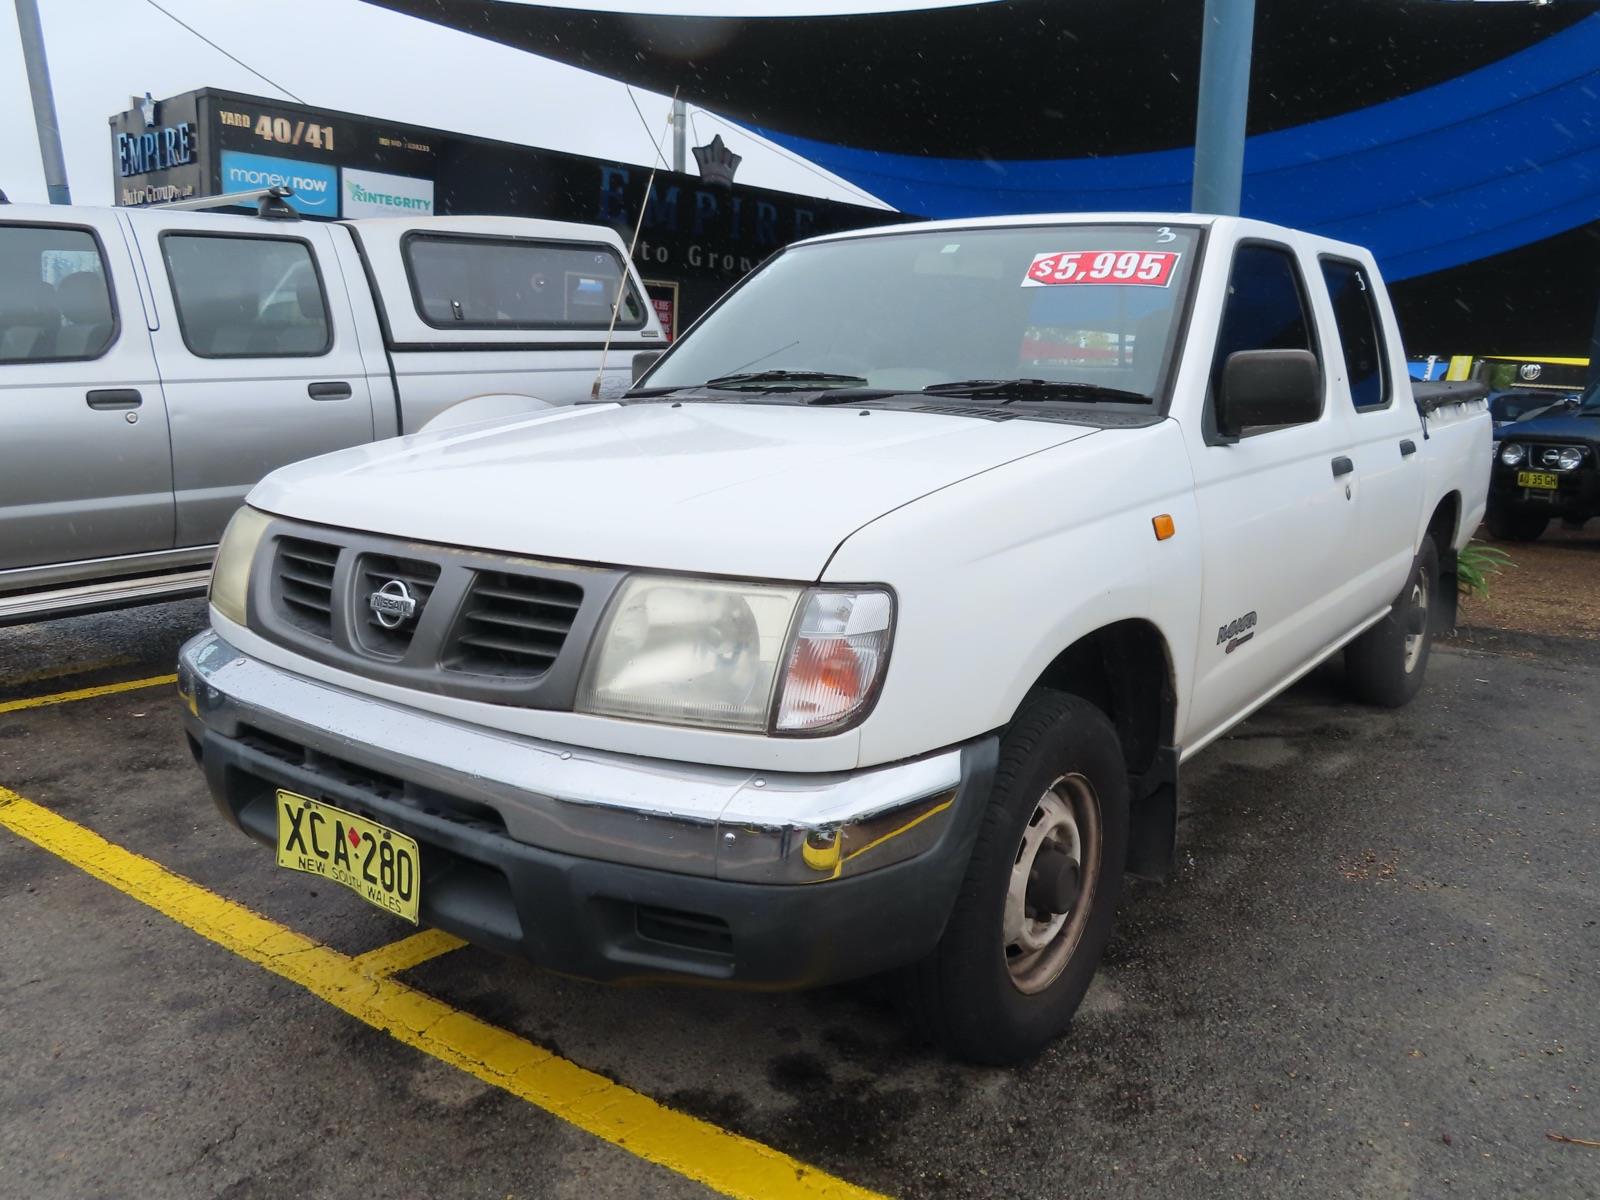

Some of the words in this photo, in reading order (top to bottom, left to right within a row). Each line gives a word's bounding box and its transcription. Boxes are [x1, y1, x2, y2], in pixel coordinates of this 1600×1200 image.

[219, 110, 250, 128] YARD
[255, 115, 334, 151] 40/41
[117, 122, 190, 177] EMPIRE
[230, 168, 290, 187] money
[293, 175, 328, 192] now
[362, 191, 431, 210] INTEGRITY
[1157, 227, 1177, 243] 3
[1035, 252, 1167, 281] $5,995
[374, 596, 408, 612] NISSAN
[284, 803, 351, 871] XCA
[362, 832, 413, 902] 280
[298, 856, 325, 873] NEW
[332, 866, 362, 890] SOUTH
[367, 886, 401, 913] WALES
